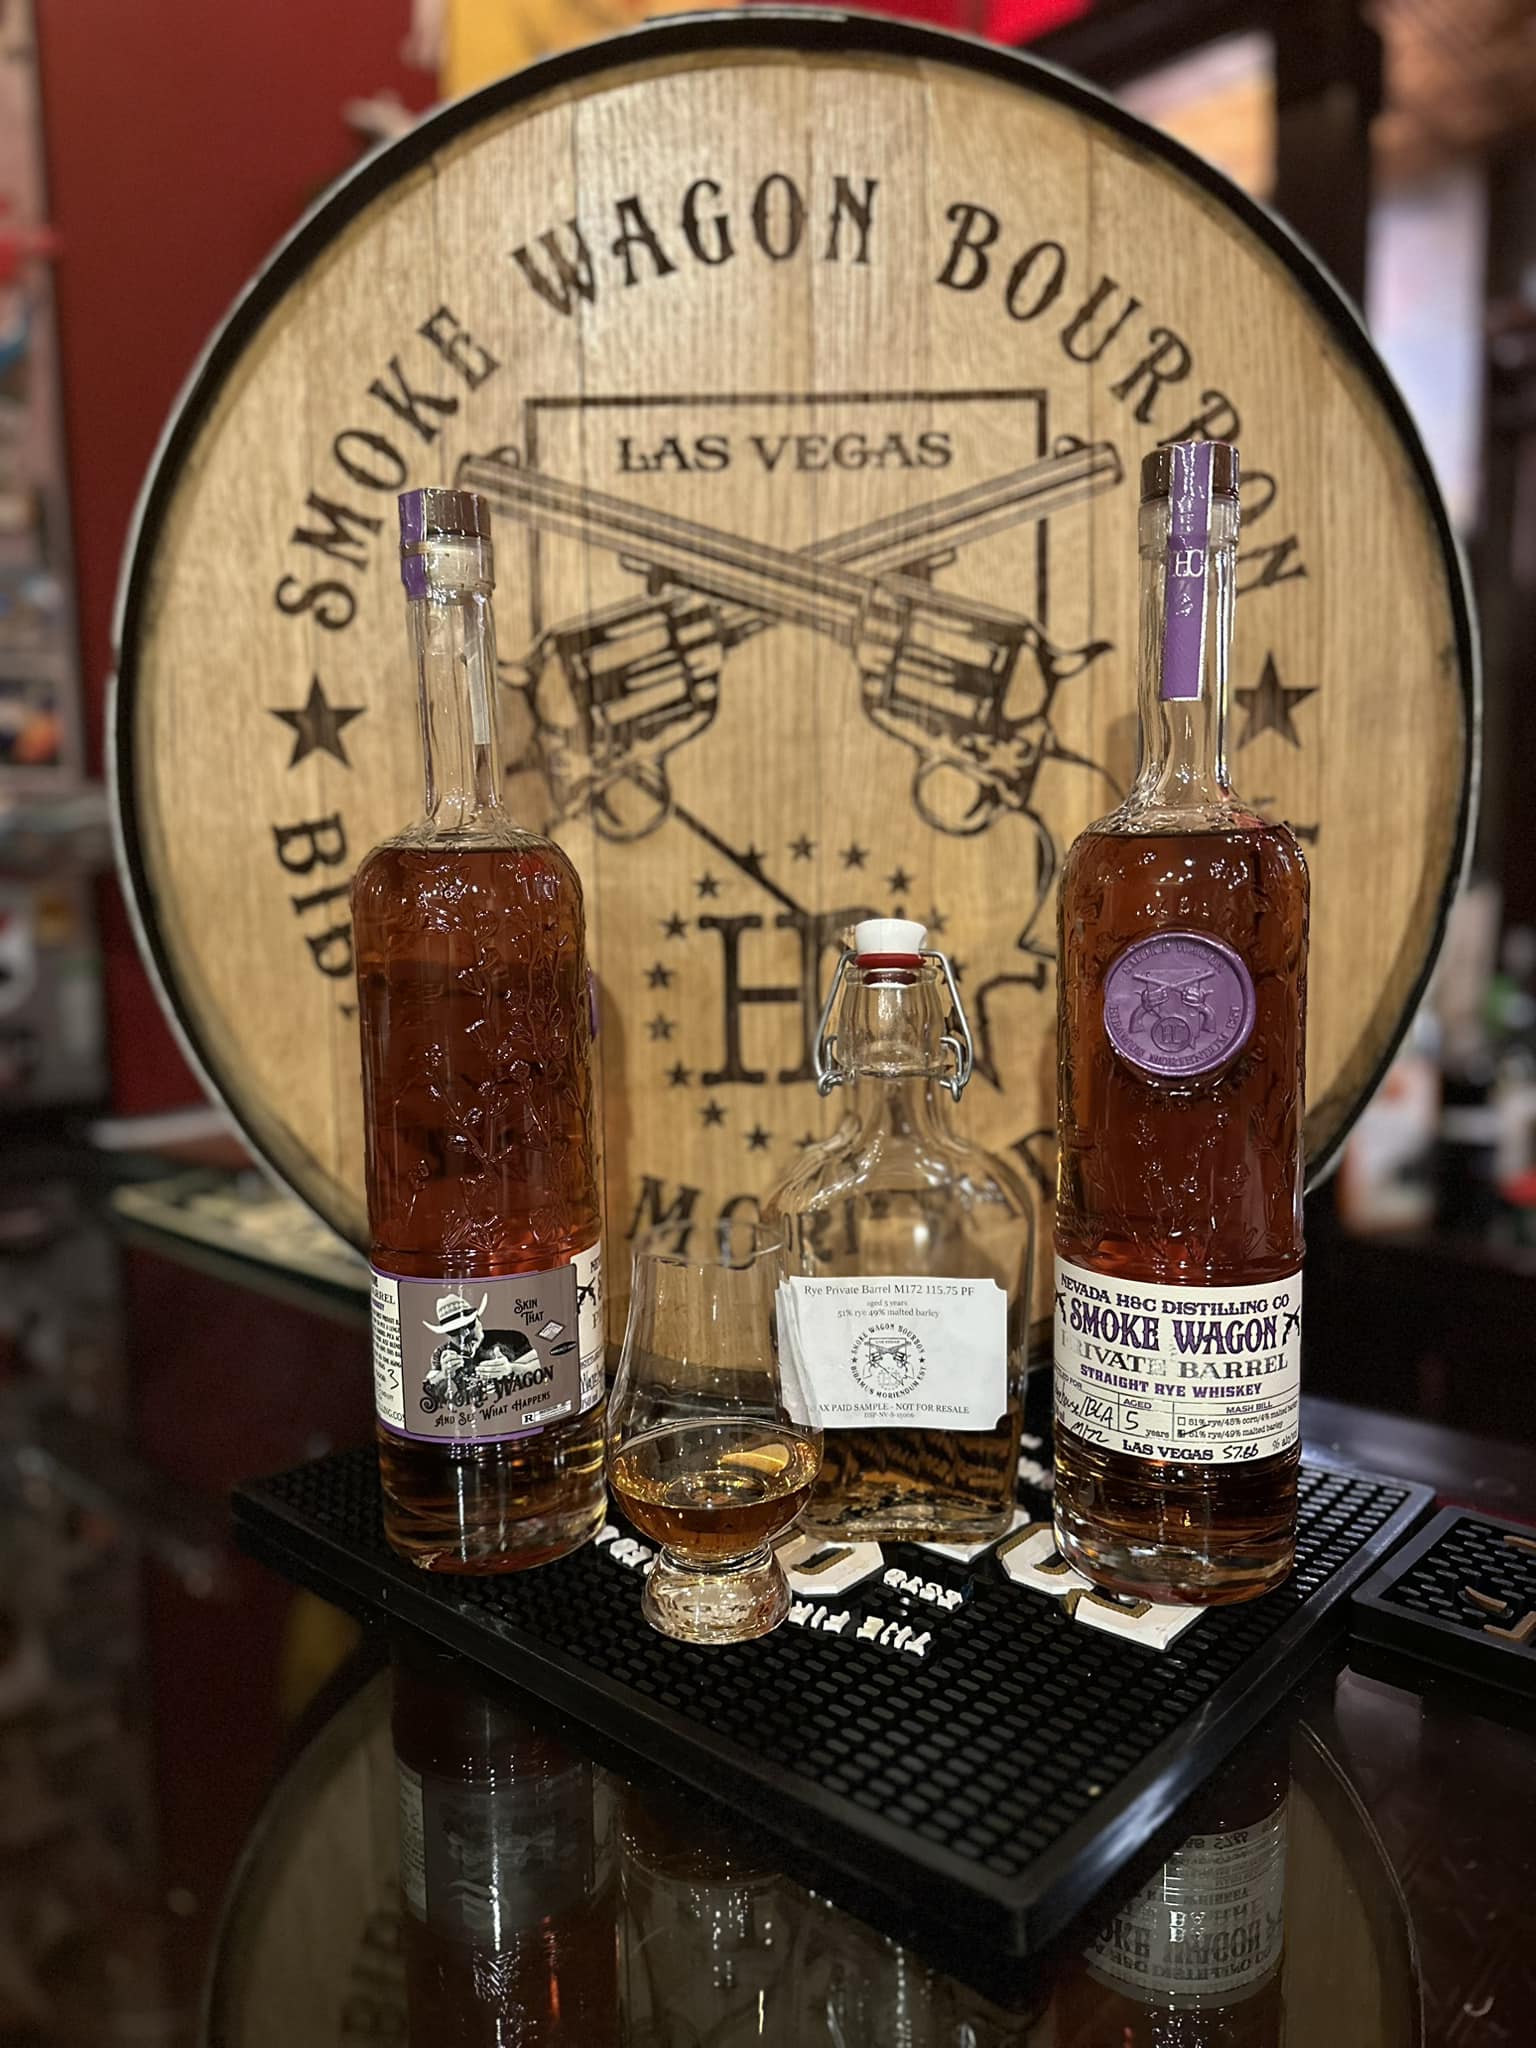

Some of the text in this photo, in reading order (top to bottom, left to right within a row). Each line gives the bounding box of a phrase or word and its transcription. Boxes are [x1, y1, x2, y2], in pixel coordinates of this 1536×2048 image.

[275, 306, 500, 632] SMOKE
[511, 173, 879, 316] WAGON
[617, 431, 953, 473] LAS VEGAS
[804, 1285, 823, 1296] Rye
[826, 1285, 859, 1295] Private
[862, 1284, 891, 1294] Barrel
[894, 1284, 923, 1295] M172
[926, 1285, 958, 1296] 115.75
[1061, 1273, 1289, 1315] NEVADA H&C DISTILLING CO
[513, 1298, 538, 1314] SKIN
[520, 1311, 545, 1326] THAT
[1070, 1297, 1277, 1354] SMOKE WAGON
[1178, 1353, 1288, 1379] BARREL
[1080, 1364, 1149, 1393] STRAIGHT
[1154, 1383, 1185, 1397] RYE
[1192, 1382, 1262, 1398] WHISKEY
[479, 1405, 508, 1421] WHAT
[511, 1391, 551, 1411] HAPPENS
[818, 1404, 829, 1412] AX
[831, 1403, 852, 1412] PAID
[854, 1403, 889, 1411] SAMPLE
[895, 1403, 914, 1411] NOT
[916, 1403, 934, 1412] FOR
[935, 1404, 970, 1414] RESALE
[1123, 1398, 1152, 1409] AGED
[1226, 1401, 1273, 1414] MASH BILL
[524, 1413, 533, 1423] R
[1124, 1411, 1139, 1430] 5
[1145, 1429, 1170, 1438] years
[1122, 1439, 1214, 1460] LAS VEGAS
